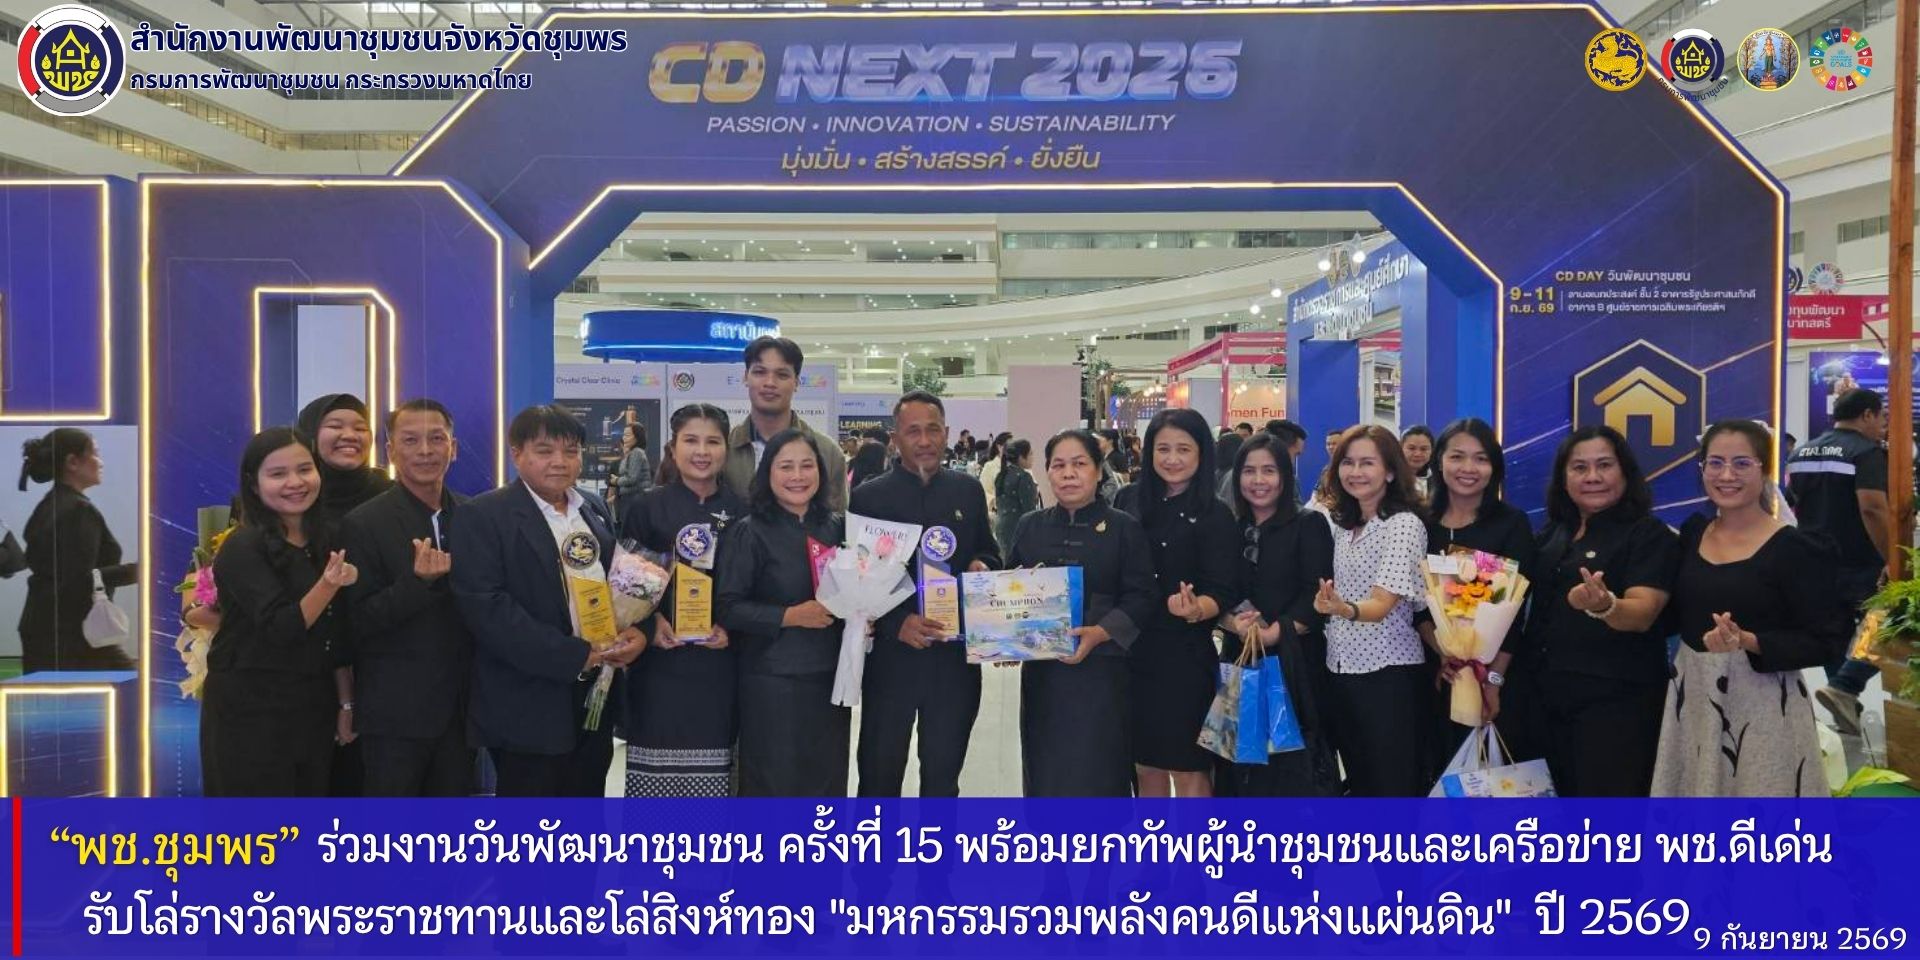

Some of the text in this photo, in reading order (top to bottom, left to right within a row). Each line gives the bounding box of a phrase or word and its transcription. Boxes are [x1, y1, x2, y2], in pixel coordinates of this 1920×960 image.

[647, 37, 1243, 104] CD NEXT 2026
[706, 113, 1176, 134] PASSION INNOVATION SUSTAINABILITY
[780, 137, 1102, 178] มุ่งมั่น สร้างสรรค์ ยั่งยืน
[1555, 269, 1691, 284] CD DAY วันพัฒนาชุมชน
[1652, 289, 1660, 299] 2
[1538, 303, 1555, 314] 69
[1227, 408, 1258, 418] men
